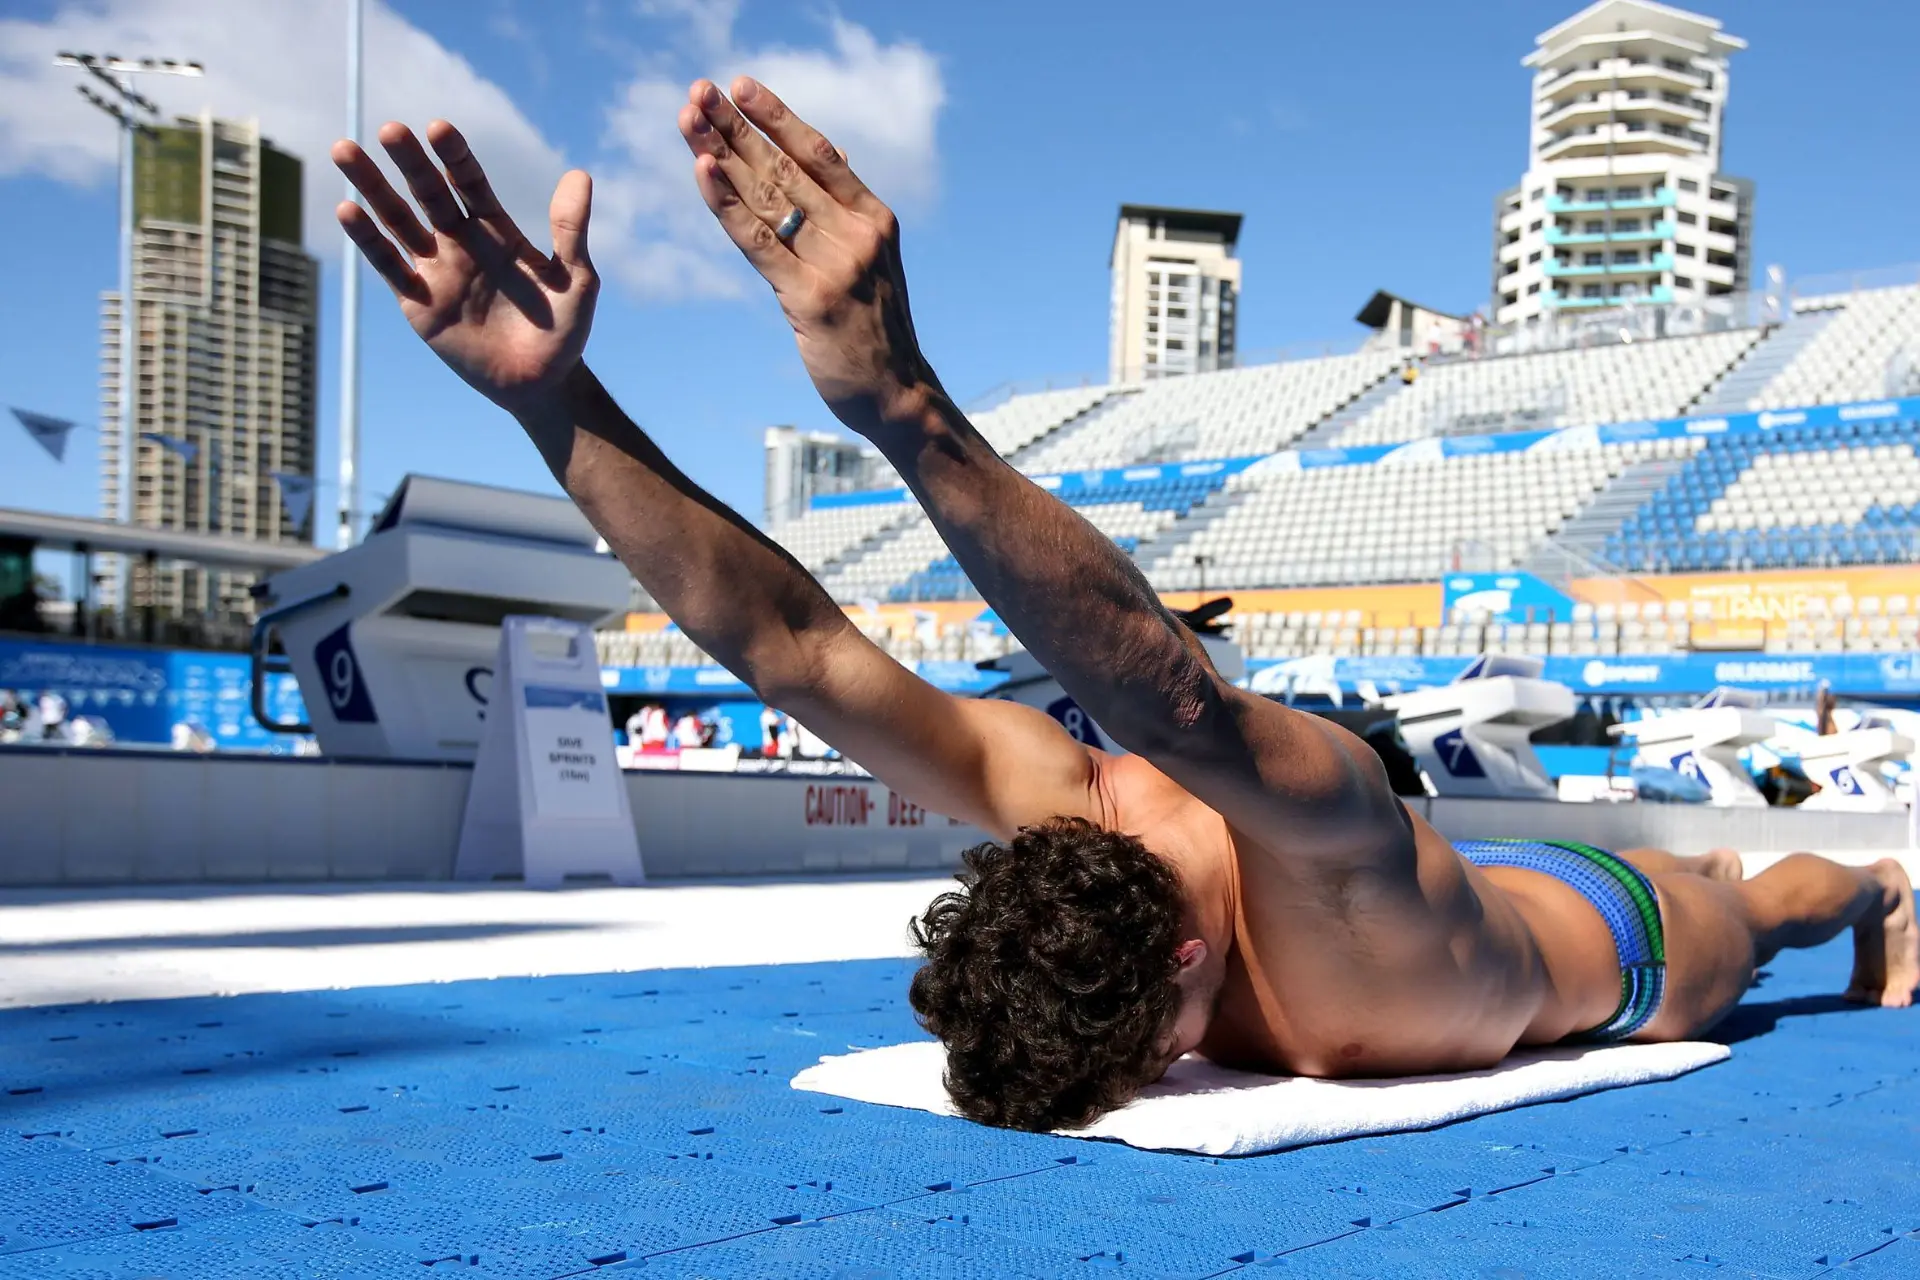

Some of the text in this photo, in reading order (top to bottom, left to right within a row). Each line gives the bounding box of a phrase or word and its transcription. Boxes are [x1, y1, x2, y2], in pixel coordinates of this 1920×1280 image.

[331, 650, 354, 709] 9
[1064, 706, 1084, 743] 8
[1446, 738, 1465, 771] 7
